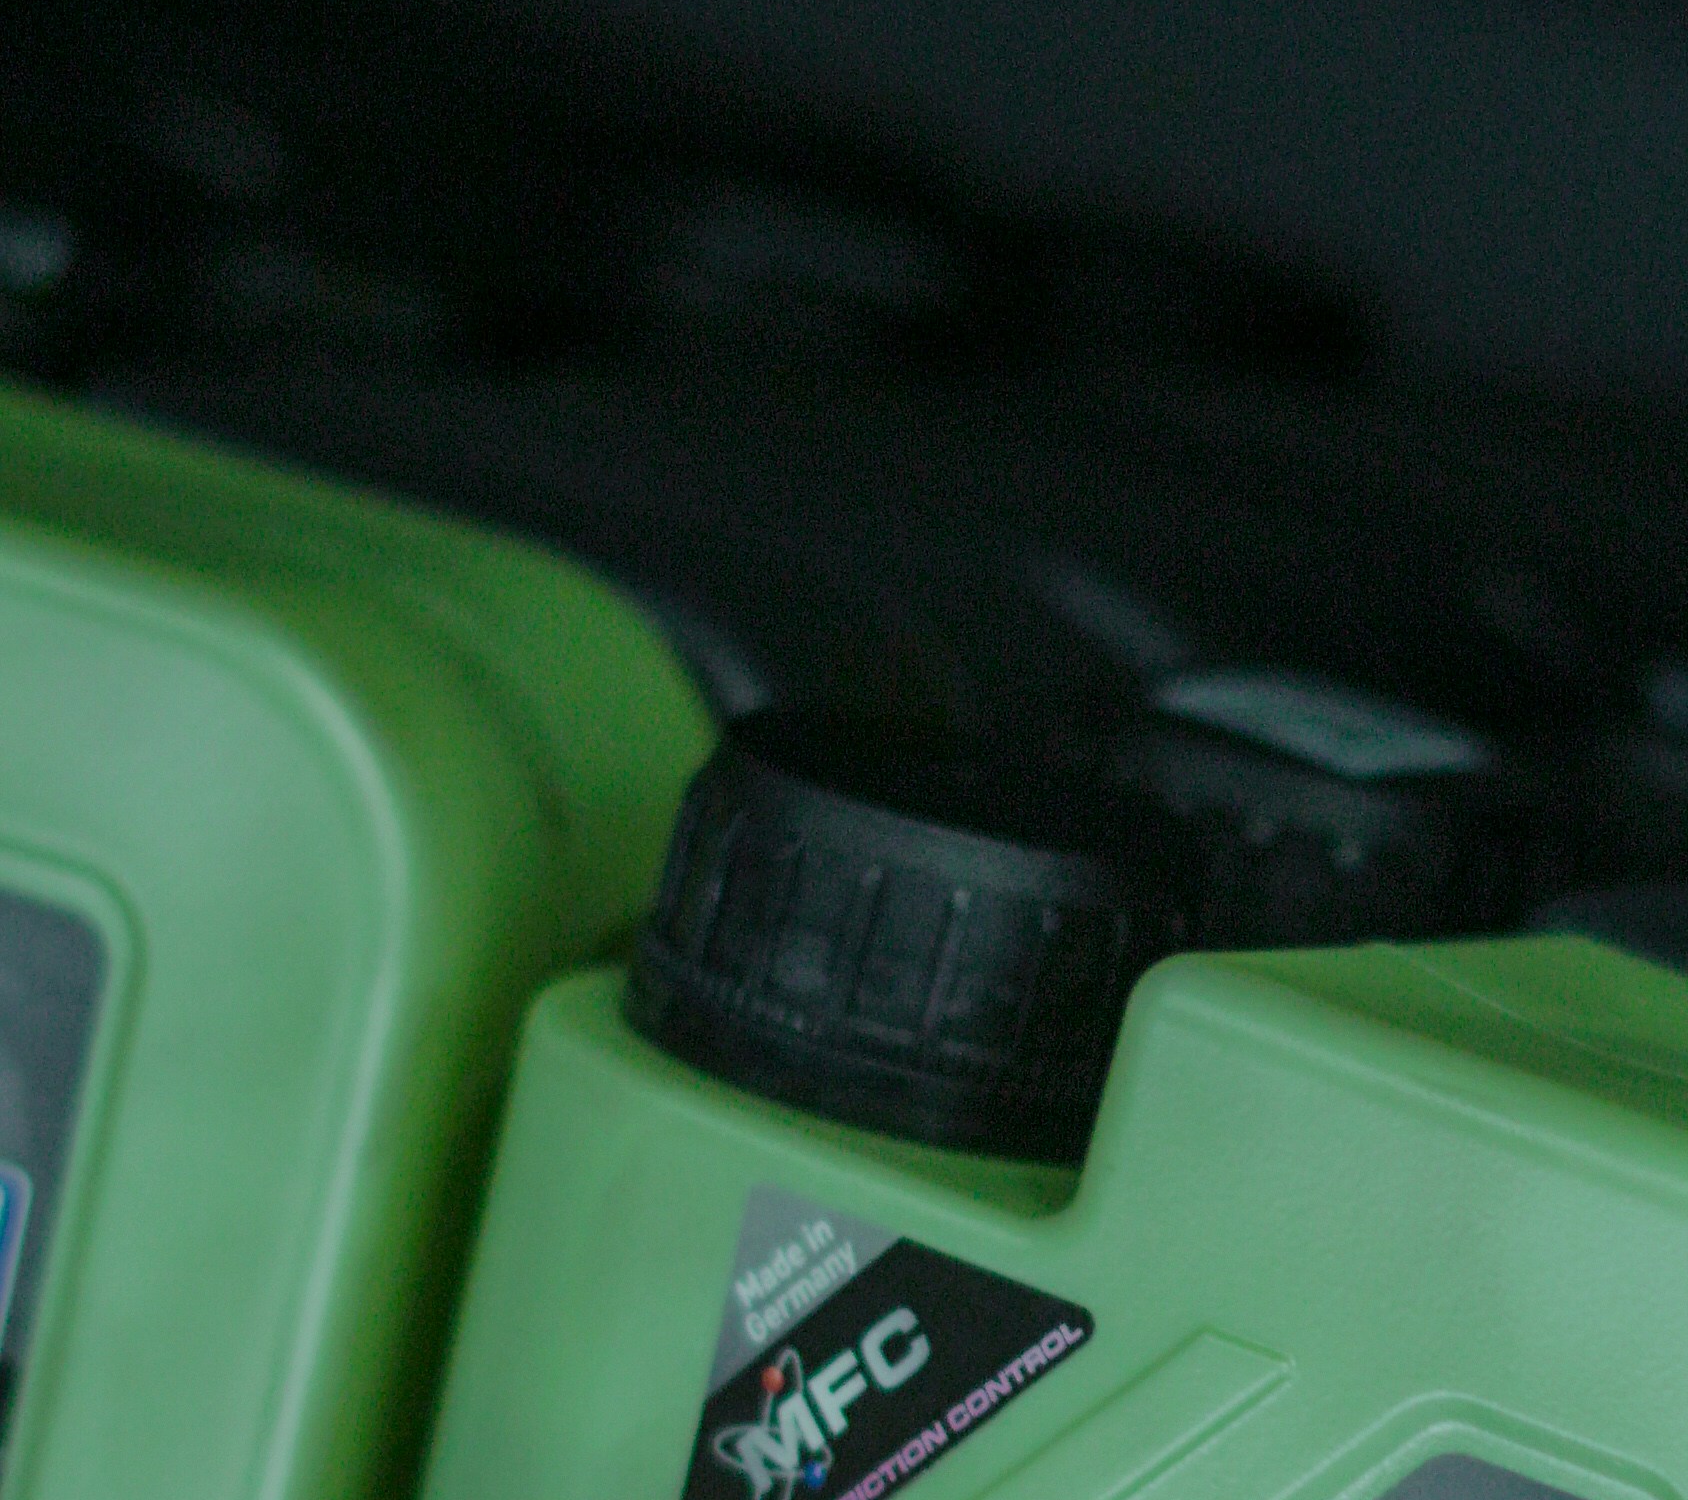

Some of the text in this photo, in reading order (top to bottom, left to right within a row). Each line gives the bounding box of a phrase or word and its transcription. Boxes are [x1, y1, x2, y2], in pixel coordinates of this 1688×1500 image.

[735, 1219, 835, 1307] Made in
[744, 1240, 856, 1343] Germany
[737, 1306, 931, 1494] MFC
[946, 1321, 1083, 1429] CONTROL
